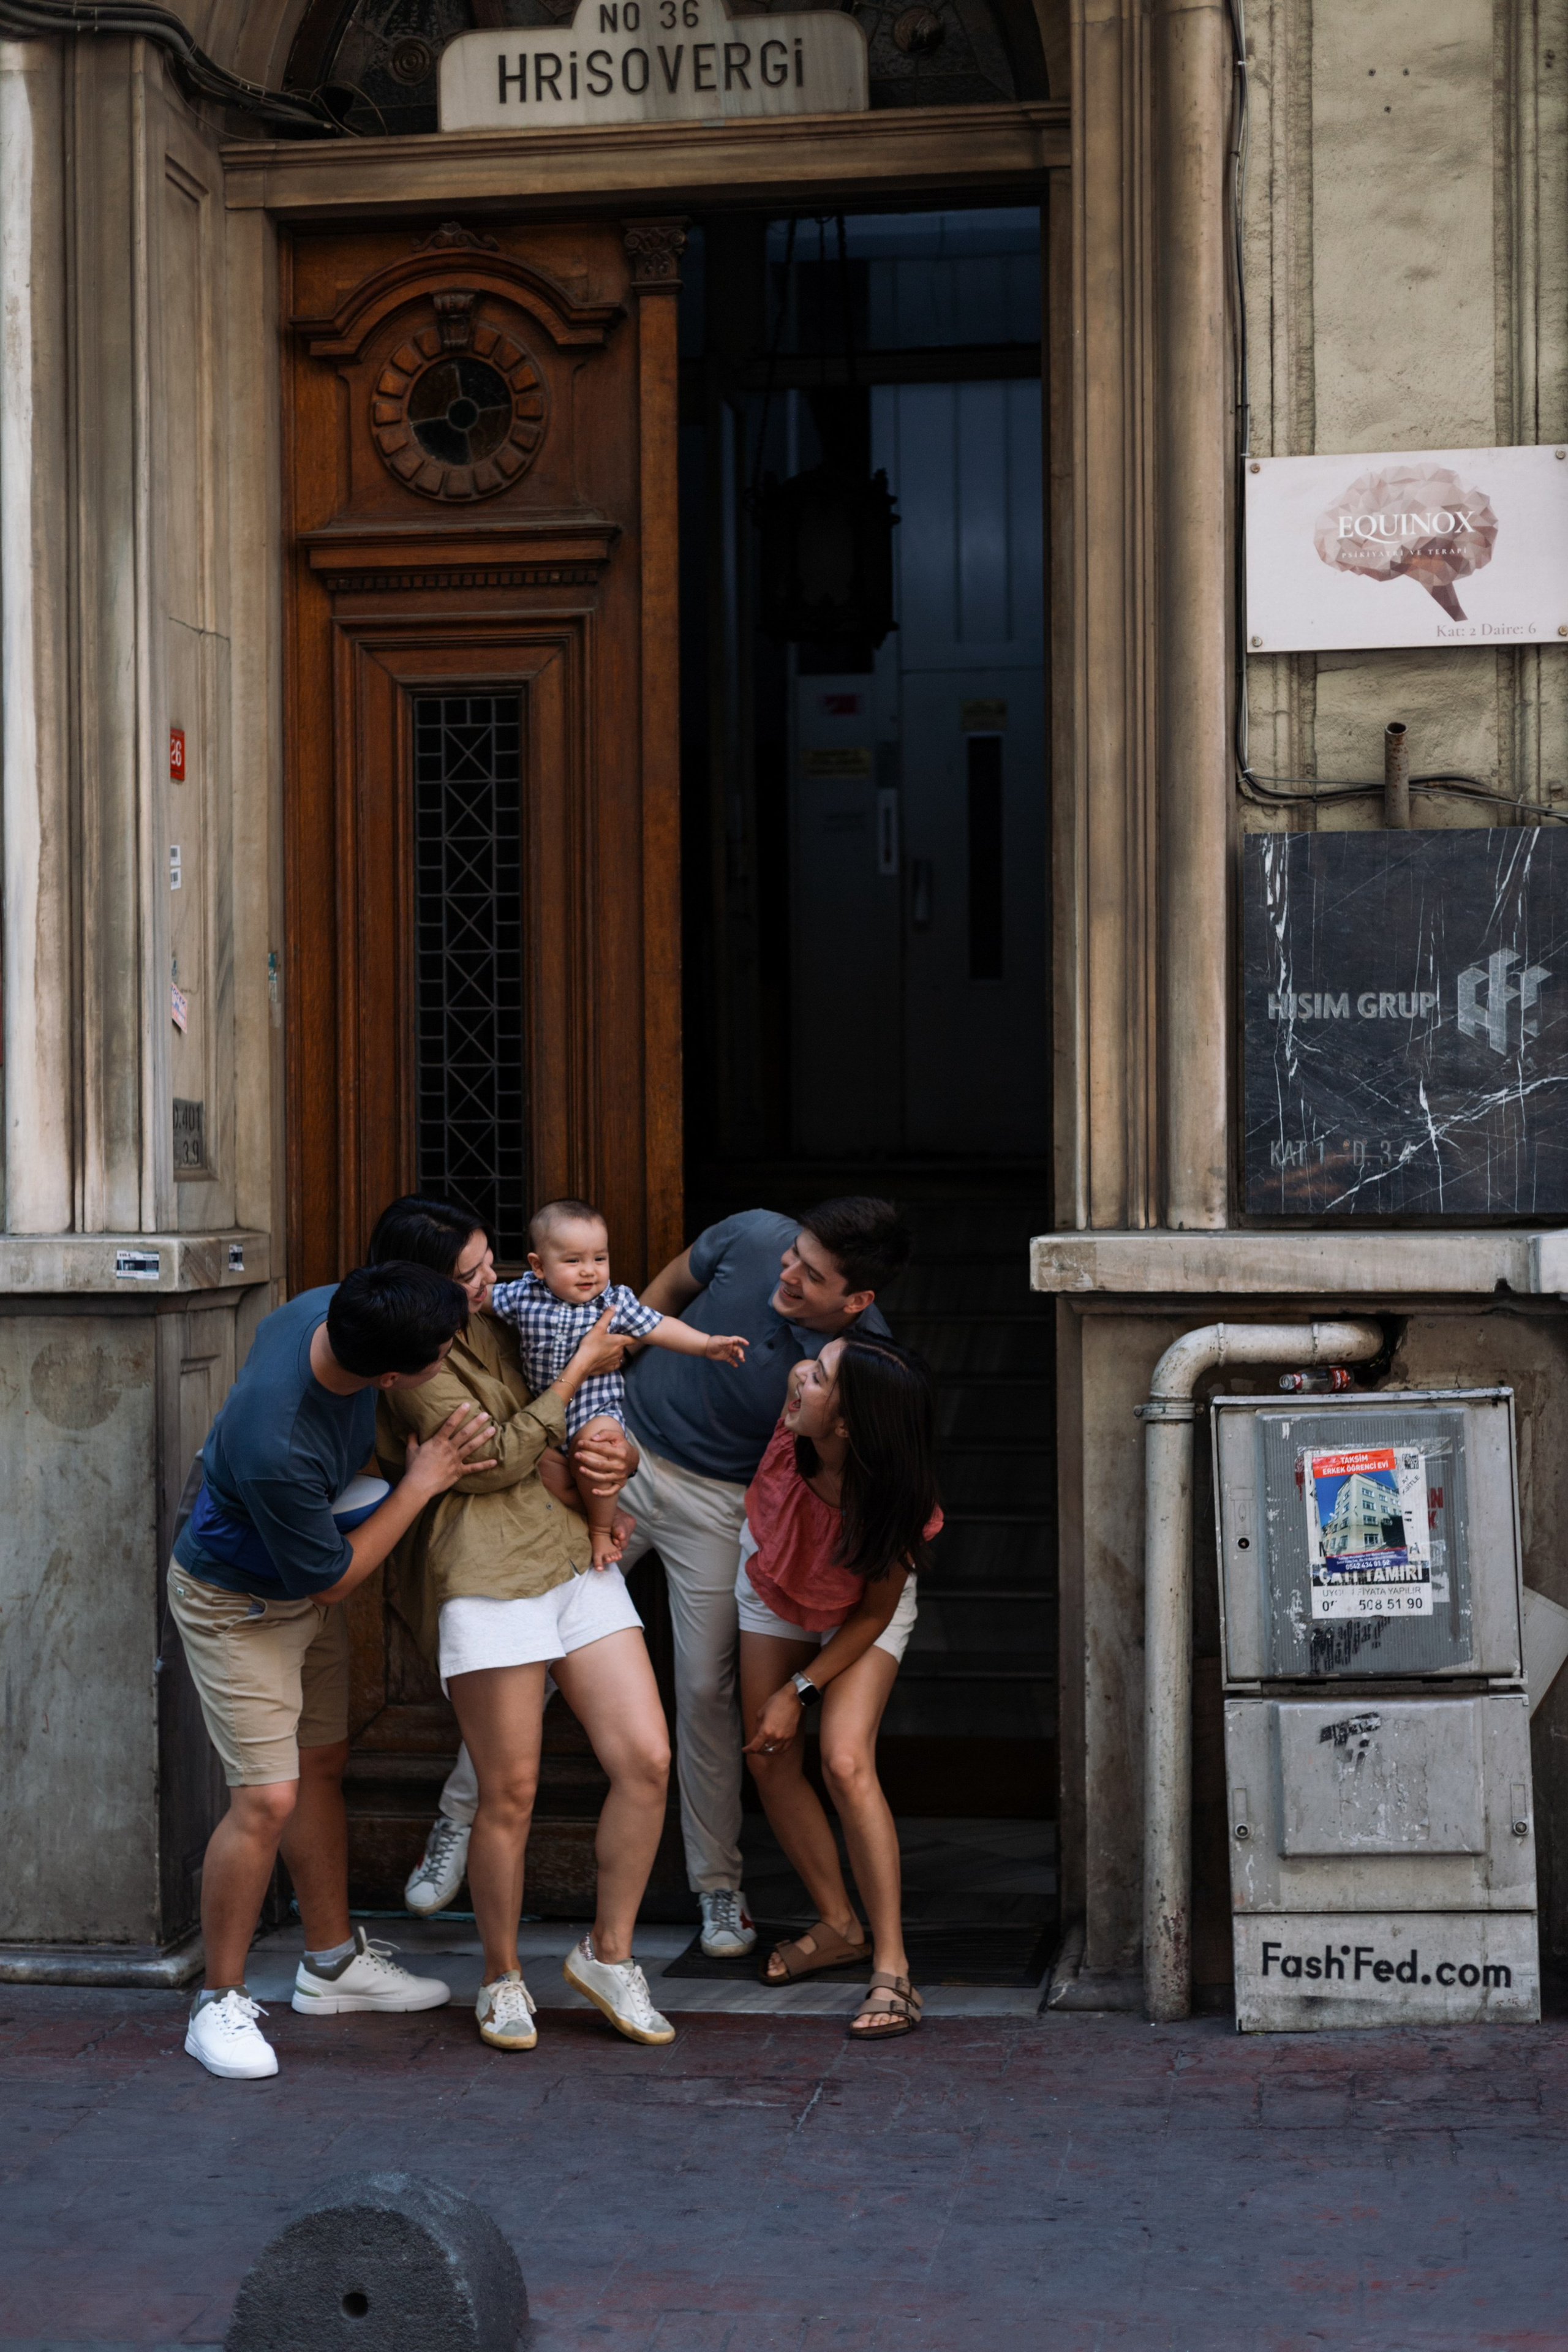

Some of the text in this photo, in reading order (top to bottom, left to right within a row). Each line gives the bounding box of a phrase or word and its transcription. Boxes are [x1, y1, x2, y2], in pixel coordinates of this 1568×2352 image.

[600, 0, 699, 33] NO 36
[1338, 511, 1476, 544] EQUINOX
[1436, 625, 1464, 637] Kat:
[1482, 623, 1523, 636] Daire:
[1528, 622, 1536, 635] 6
[171, 739, 182, 767] 26
[1357, 992, 1436, 1019] GRUP
[1271, 1140, 1307, 1167] KAT
[1316, 1140, 1324, 1165] 1
[1322, 1460, 1389, 1476] ERKEK ÖĞRENCİ EVİ
[1340, 1454, 1368, 1464] TAKSİM
[1387, 1599, 1401, 1610] 51
[1407, 1597, 1422, 1609] 90
